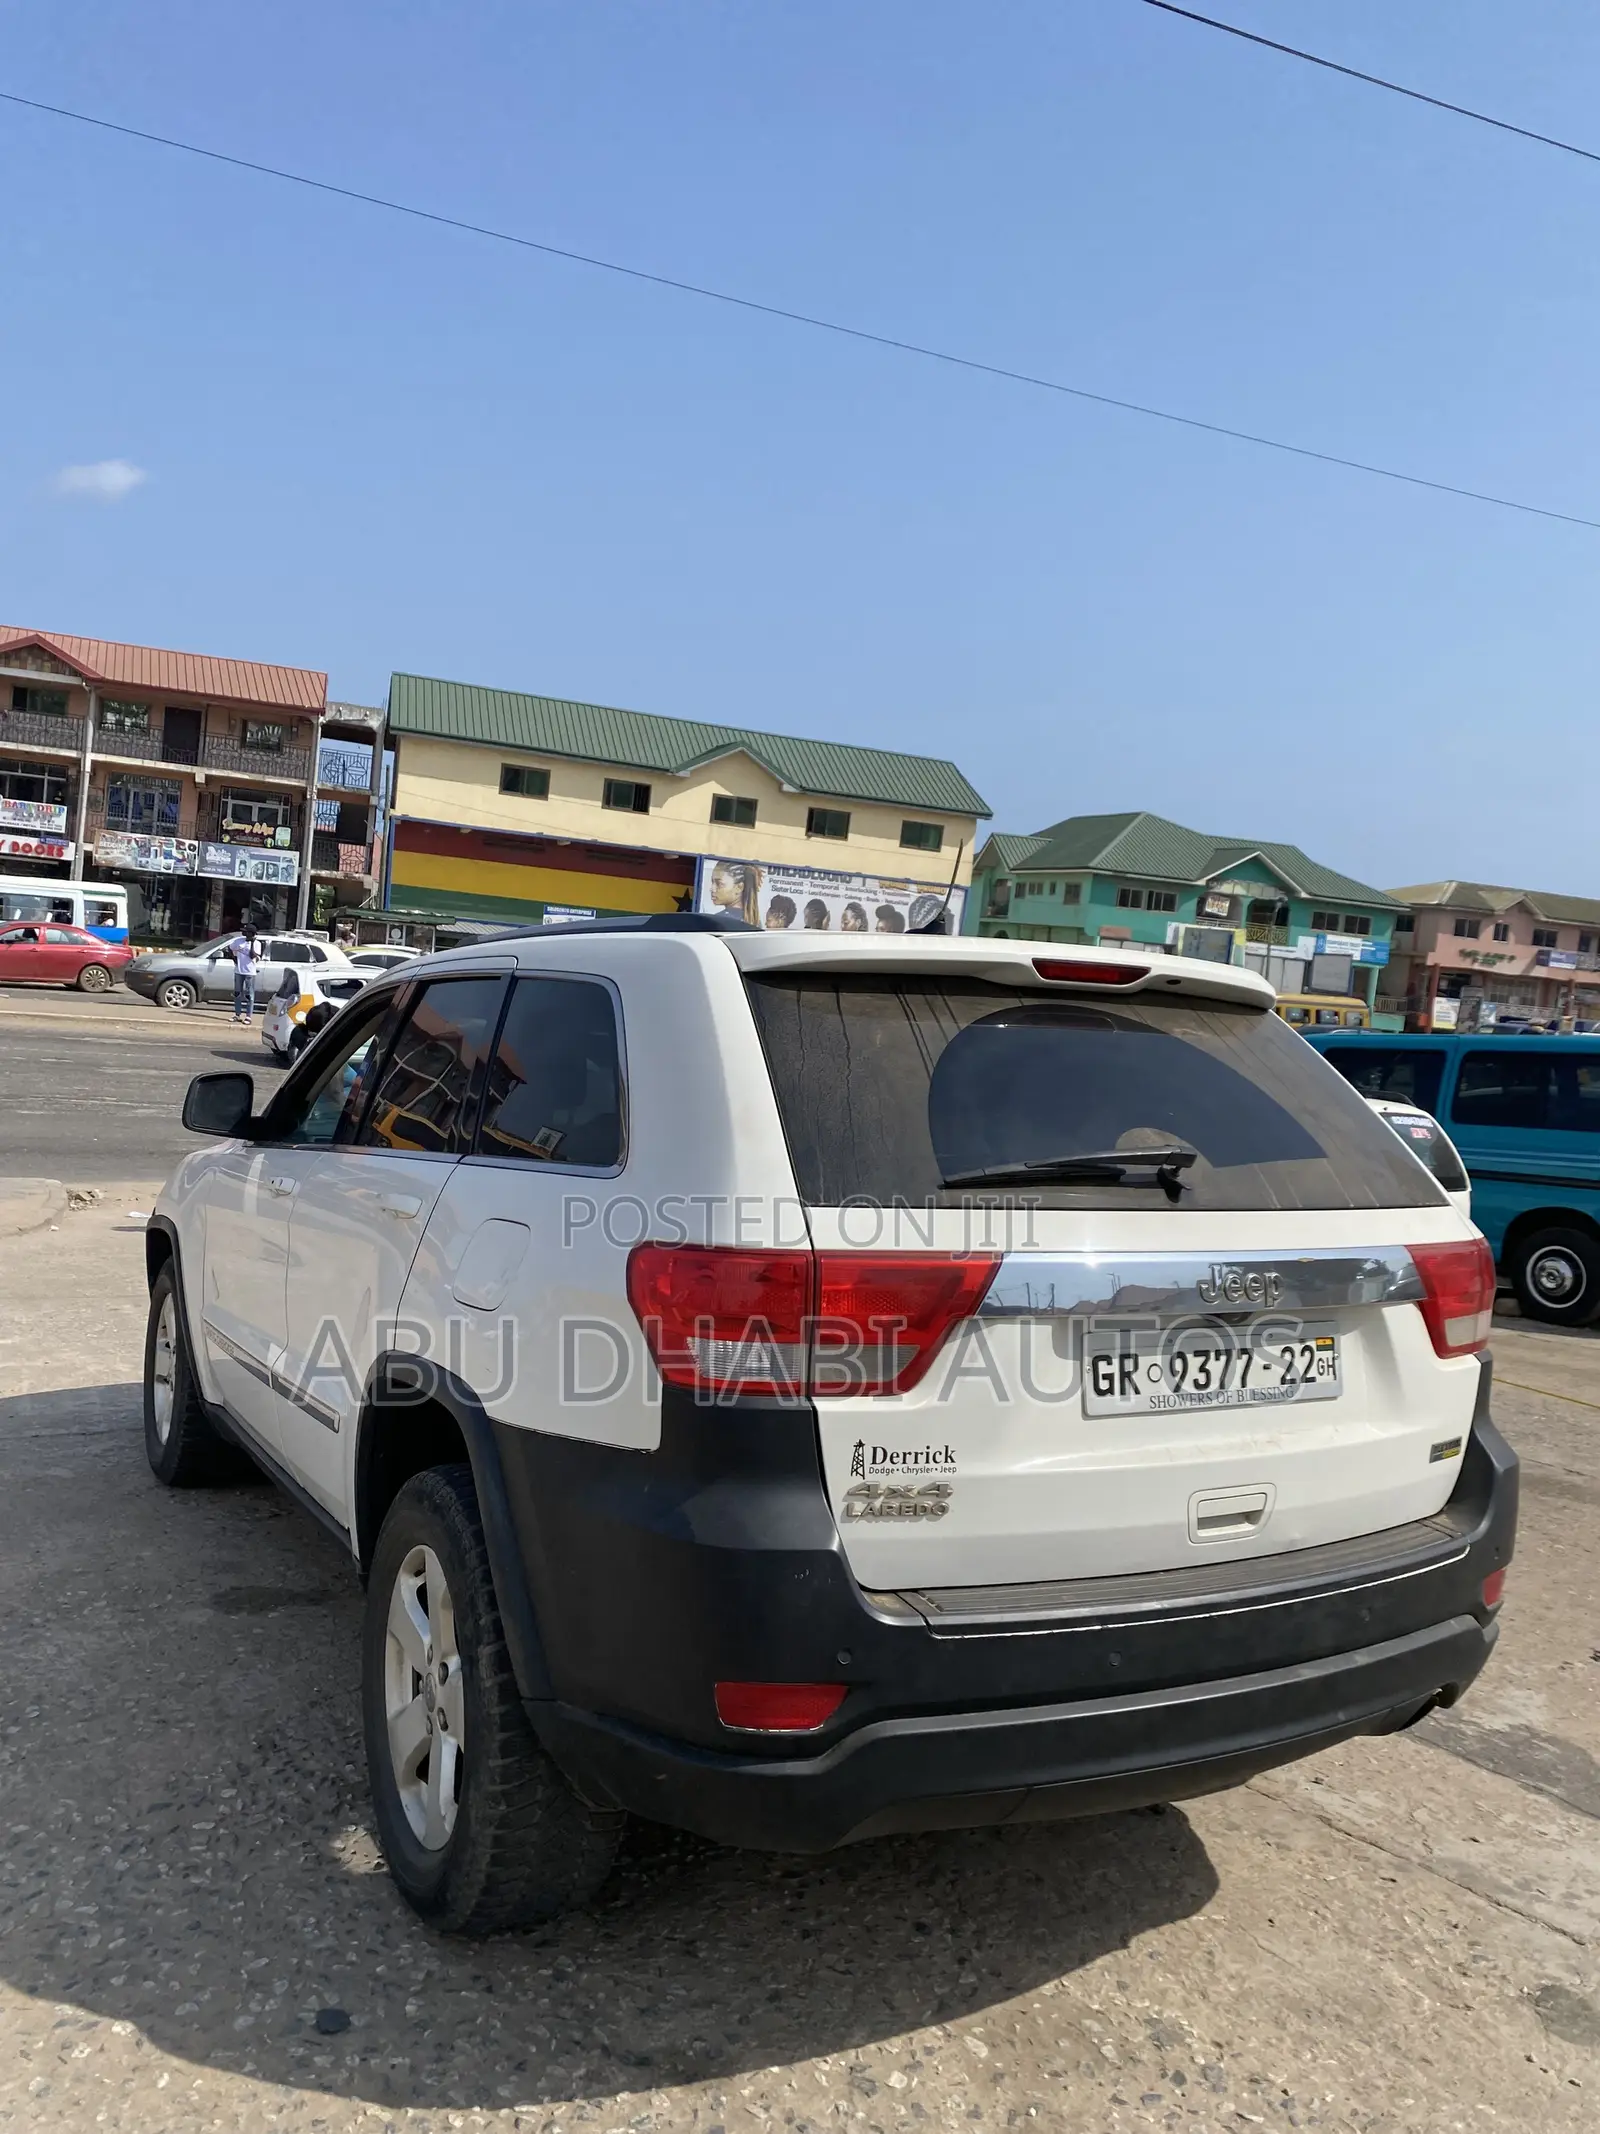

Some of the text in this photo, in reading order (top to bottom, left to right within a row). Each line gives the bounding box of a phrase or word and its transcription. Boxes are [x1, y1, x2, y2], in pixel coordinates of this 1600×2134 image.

[11, 840, 65, 858] DOORS
[769, 877, 804, 887] Permanent
[809, 881, 840, 891] Temporal
[1199, 1263, 1286, 1308] Jeep
[1091, 1352, 1141, 1396] GR
[1149, 1385, 1296, 1410] SHOWERS OF BLESSING
[869, 1444, 957, 1465] Derrick
[868, 1465, 957, 1476] Dodge Chrysler Jeep
[847, 1480, 954, 1499] 4x4
[846, 1500, 951, 1518] LAREDO
